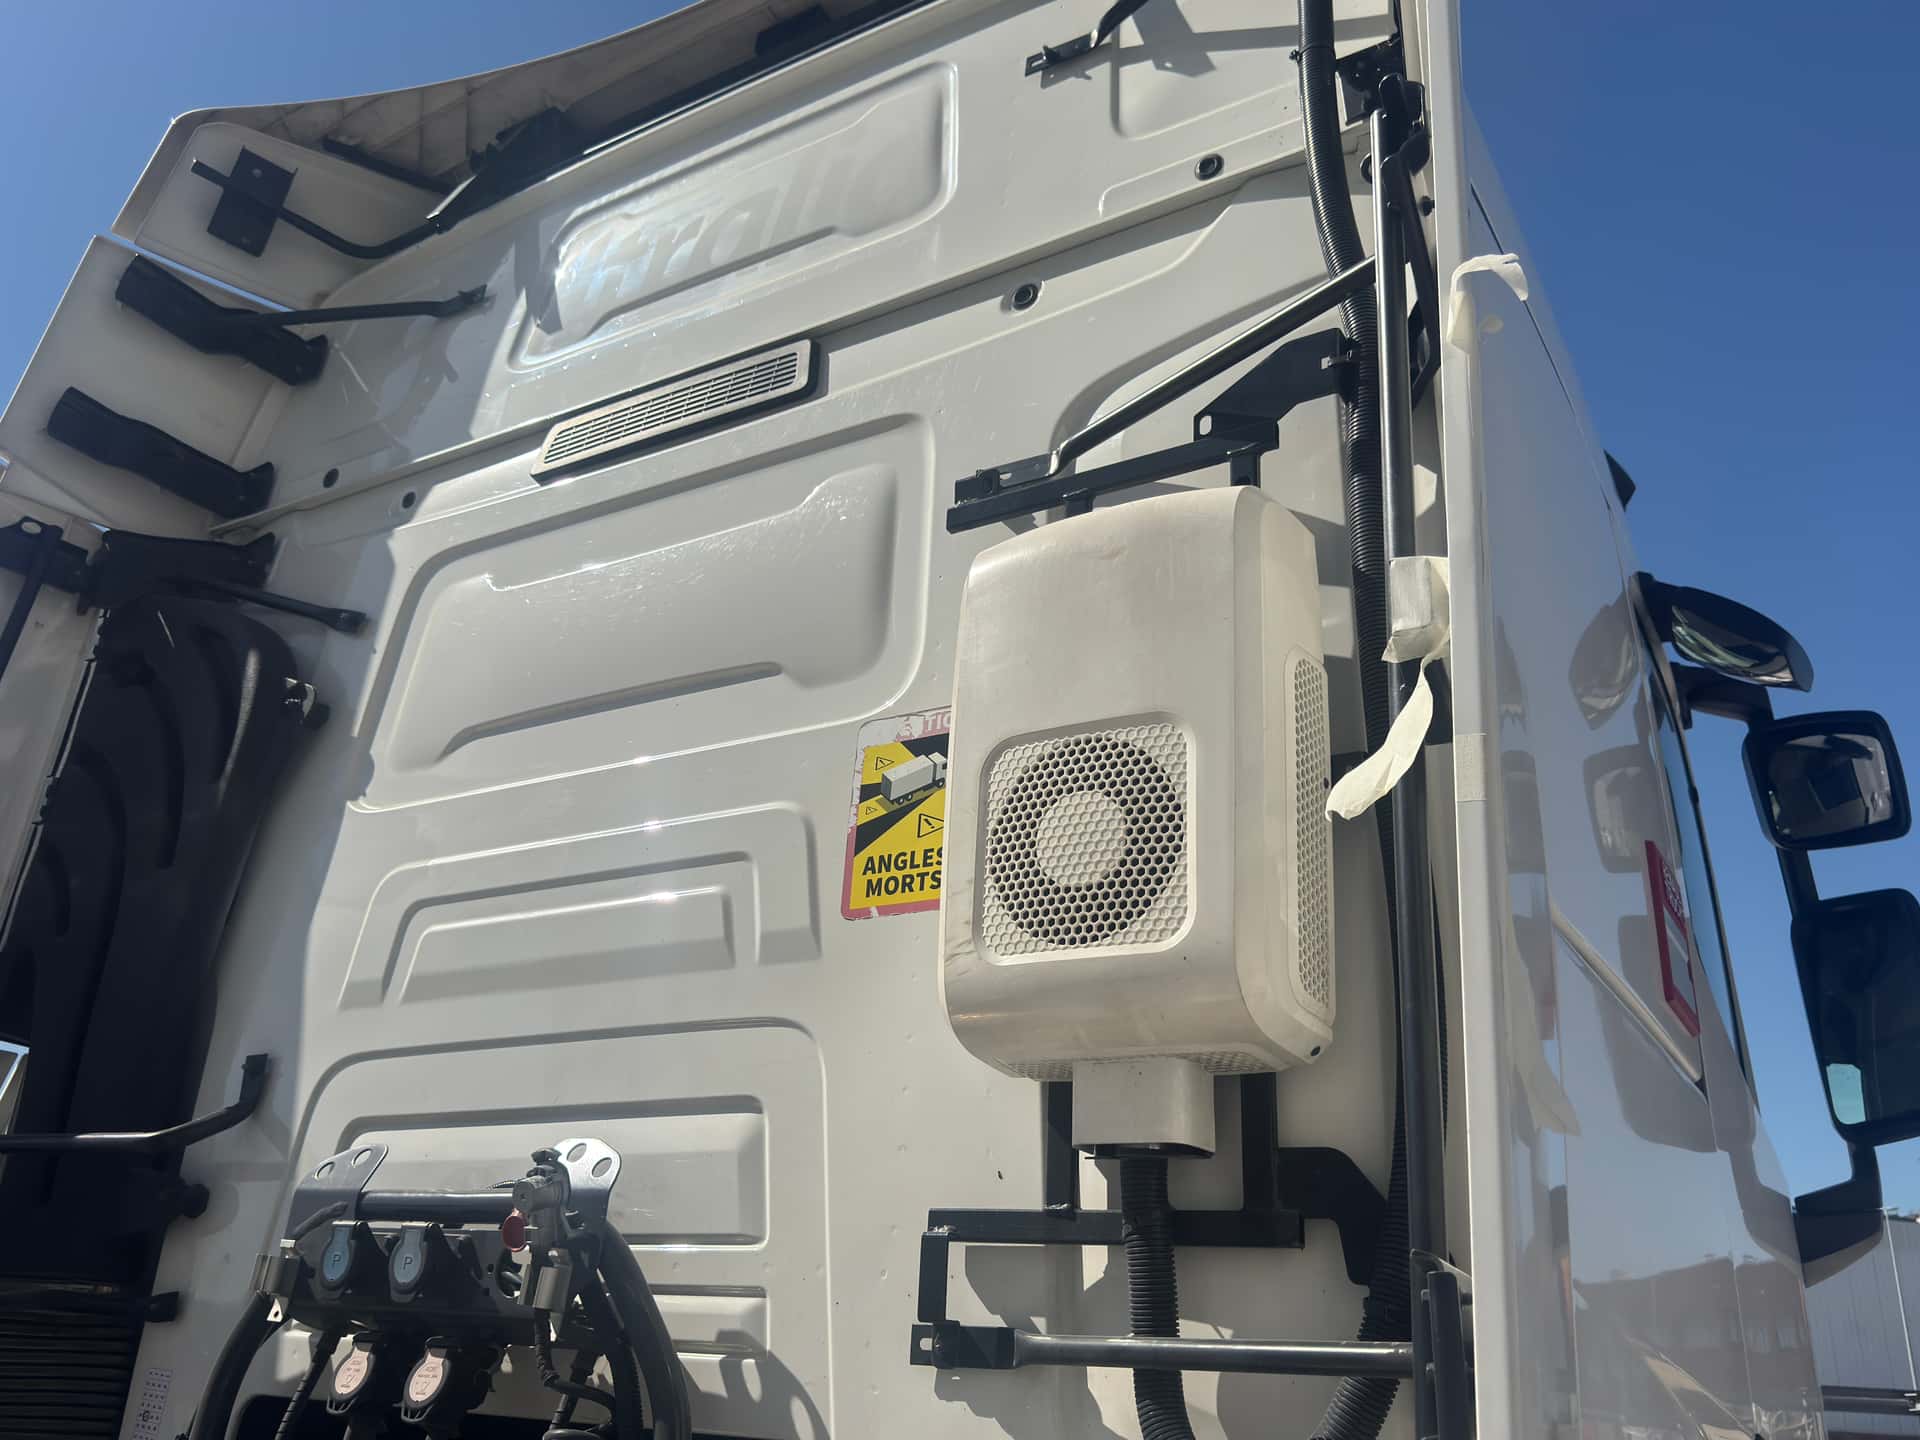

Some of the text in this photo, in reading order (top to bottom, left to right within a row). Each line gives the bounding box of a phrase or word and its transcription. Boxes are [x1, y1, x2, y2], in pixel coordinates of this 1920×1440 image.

[865, 870, 942, 898] MORTS
[332, 1253, 342, 1269] P
[403, 1256, 413, 1270] P
